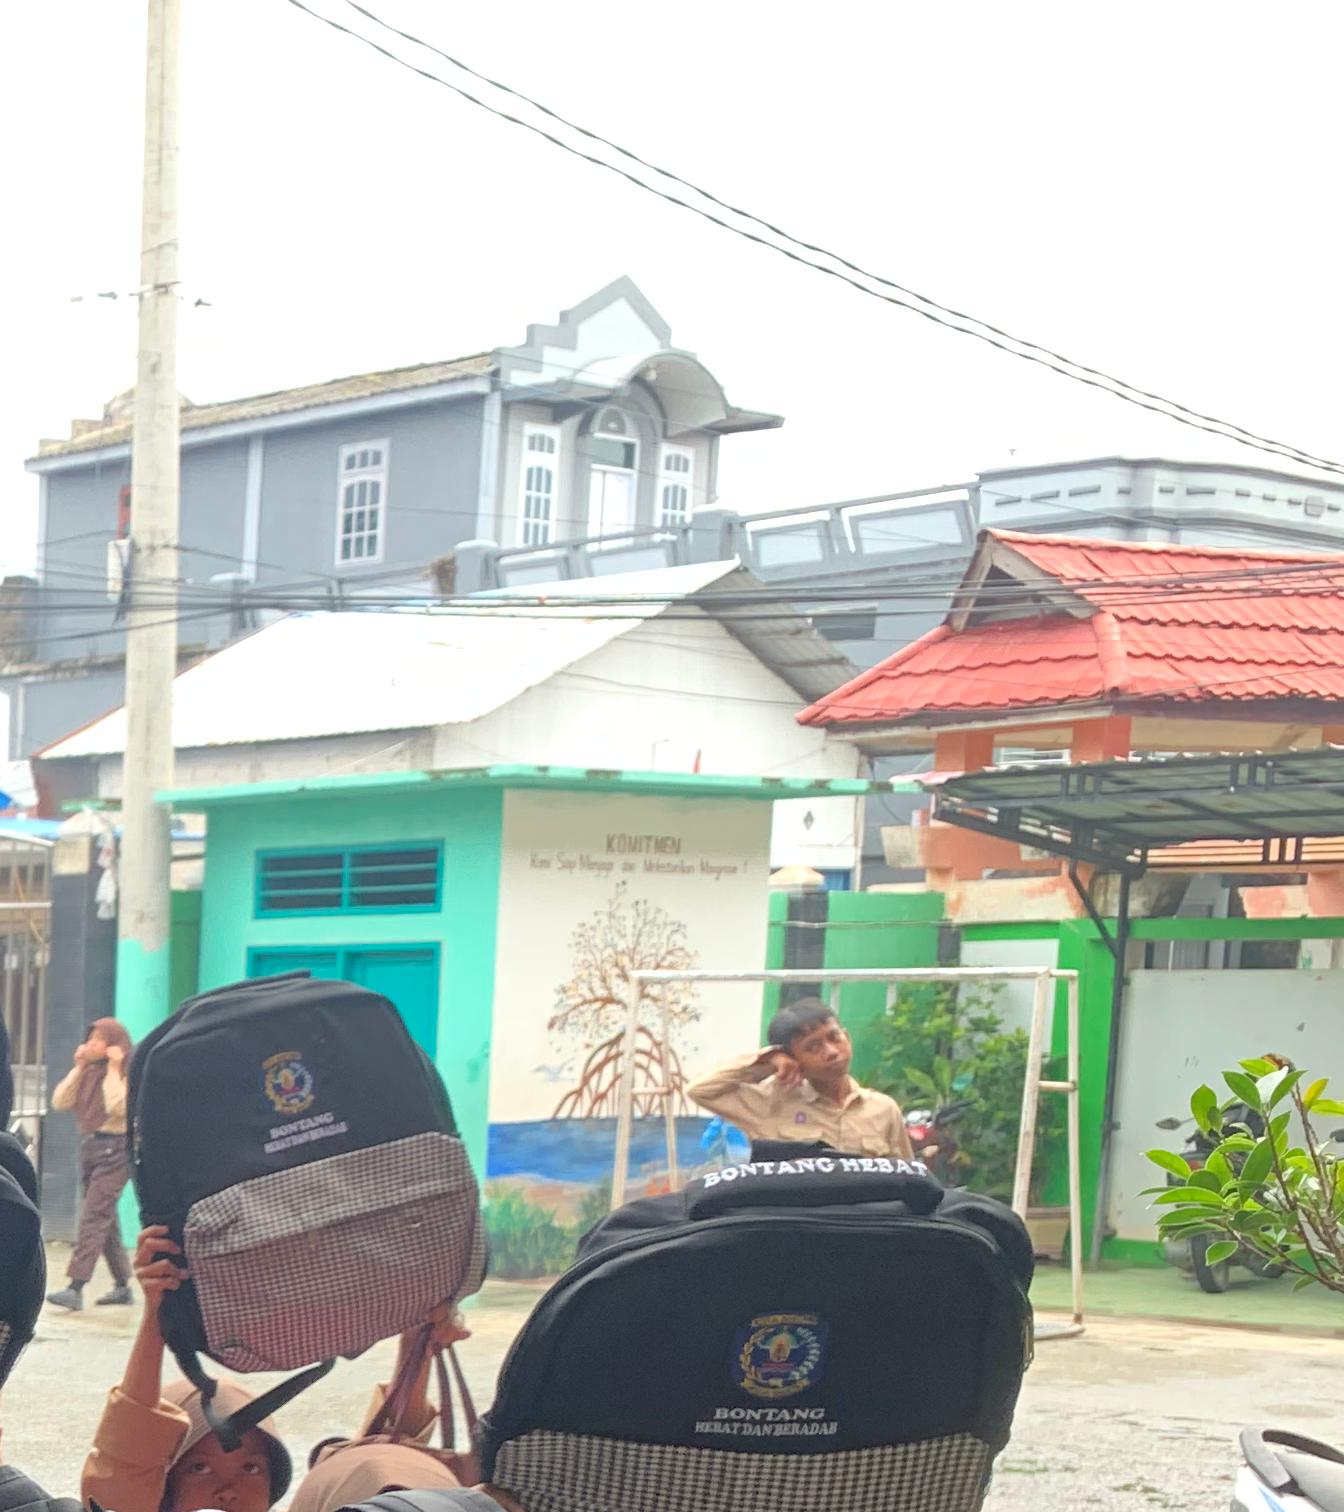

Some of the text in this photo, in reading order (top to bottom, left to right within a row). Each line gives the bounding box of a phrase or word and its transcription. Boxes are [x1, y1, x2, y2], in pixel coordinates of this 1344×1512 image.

[606, 833, 680, 854] KOMITMEN
[703, 1158, 928, 1188] BONTANG HEBAT
[714, 1407, 826, 1421] BONTANG
[695, 1421, 838, 1436] HEBAT DAN BERADAB
